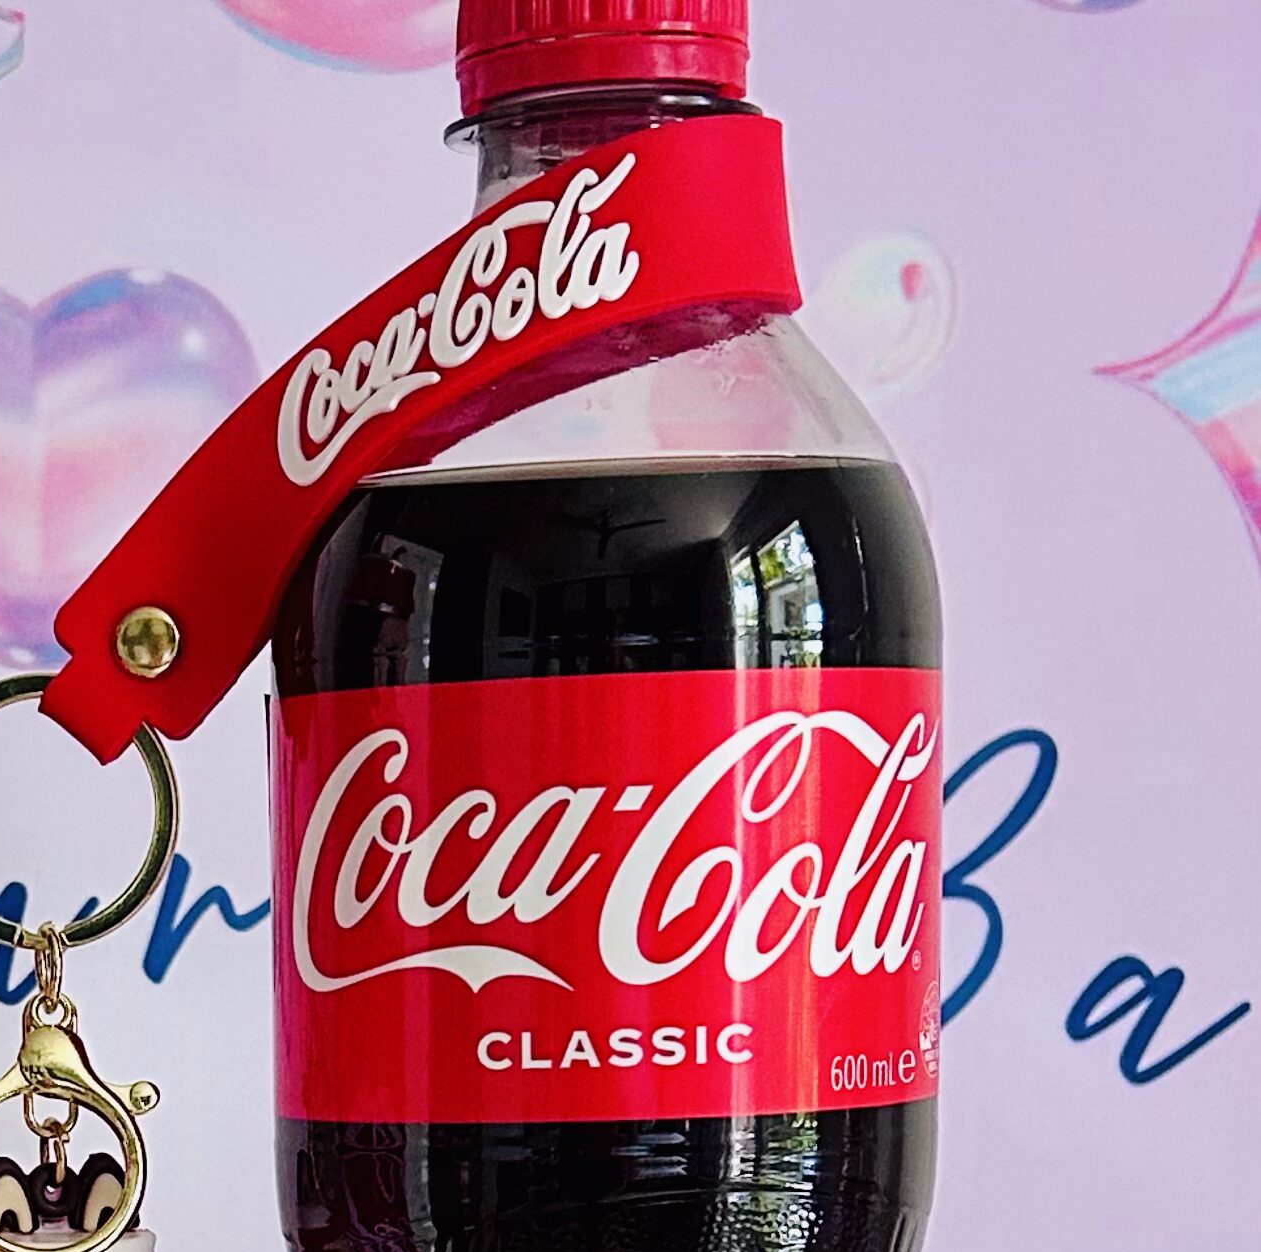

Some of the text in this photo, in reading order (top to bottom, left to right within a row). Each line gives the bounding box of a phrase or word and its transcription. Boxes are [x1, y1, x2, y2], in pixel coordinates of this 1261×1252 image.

[277, 152, 639, 487] Coca-Cola
[293, 710, 938, 994] Coca-Cola
[476, 1022, 755, 1071] CLASSIC
[831, 1053, 868, 1091] 600
